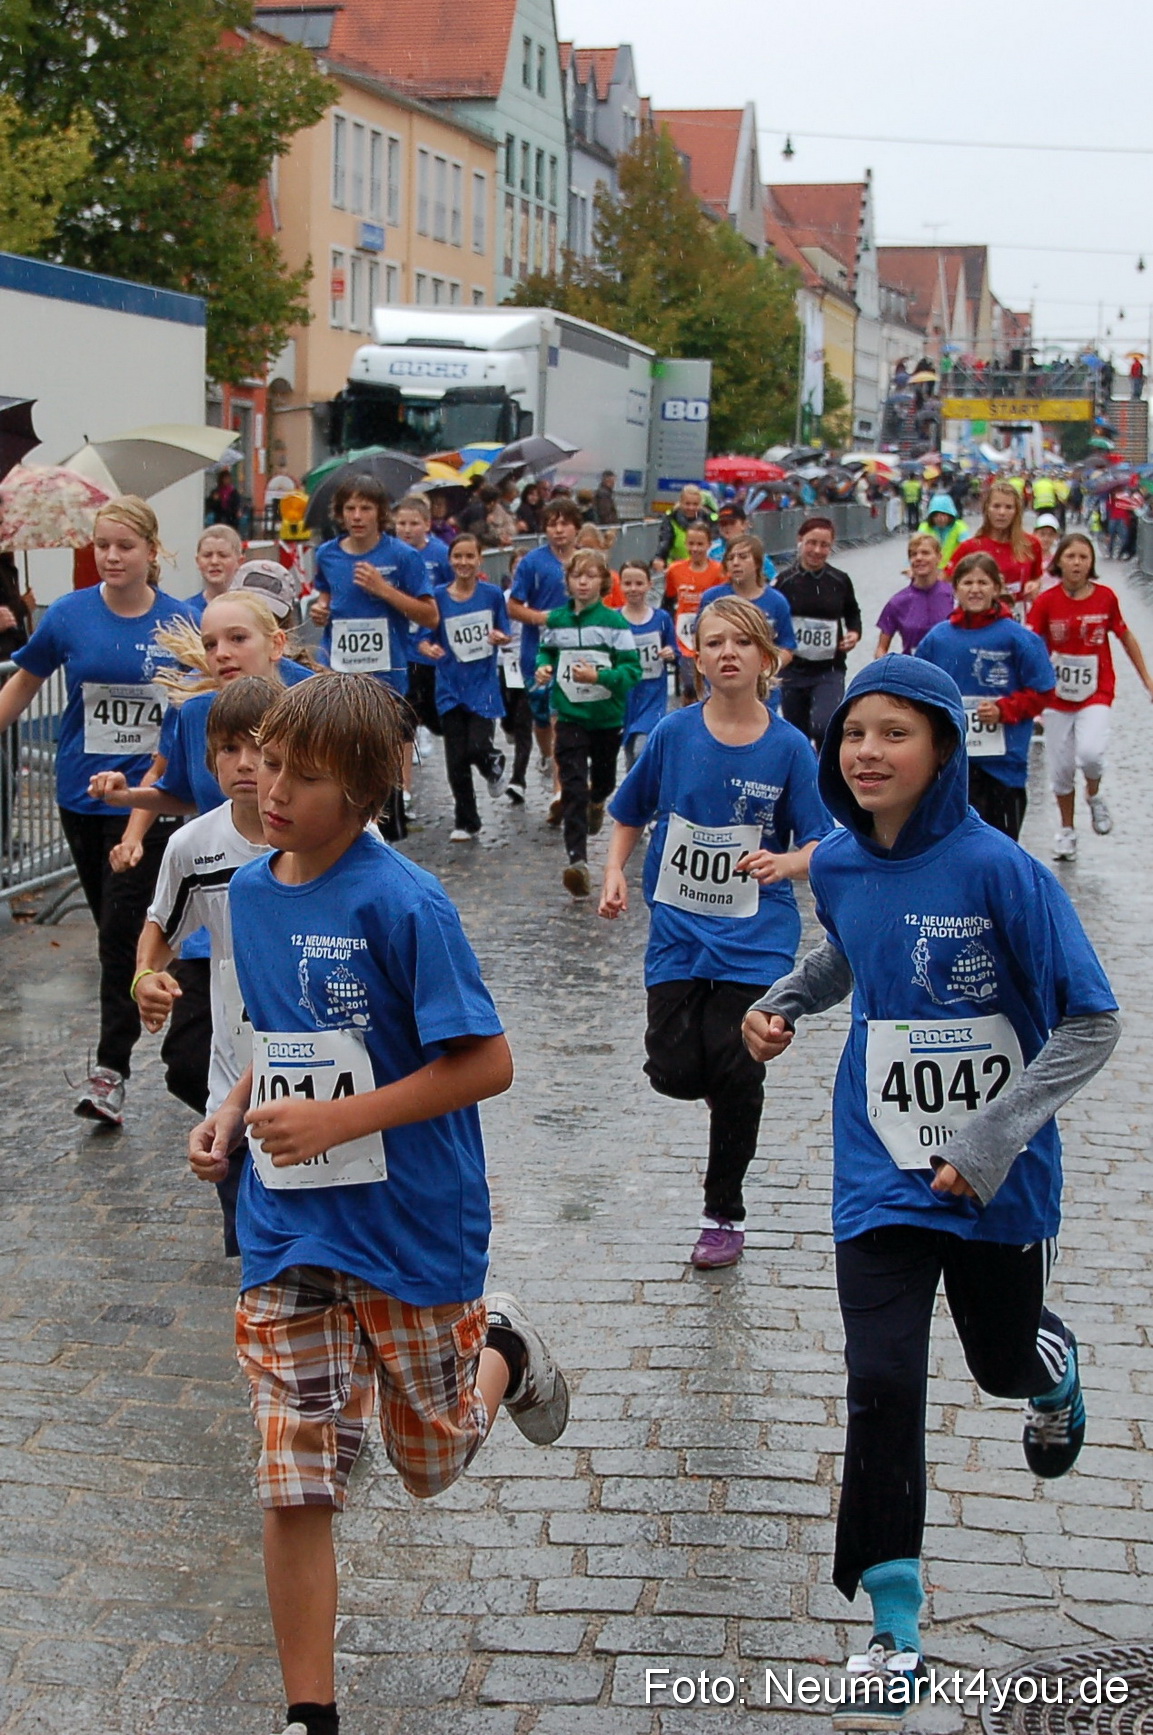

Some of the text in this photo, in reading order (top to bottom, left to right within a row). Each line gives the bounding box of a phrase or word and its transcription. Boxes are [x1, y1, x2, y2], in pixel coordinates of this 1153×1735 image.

[989, 404, 1040, 417] START
[337, 632, 384, 653] 4029
[93, 698, 163, 727] 4074
[114, 731, 142, 744] Jana
[670, 844, 751, 885] 4004
[679, 883, 734, 905] Ramona
[904, 914, 920, 925] 12.
[919, 926, 984, 938] STADTLAUF
[291, 935, 368, 950] 12. NEUMARKTER
[302, 947, 352, 961] STADTLAUF
[909, 1027, 974, 1045] BOCK
[267, 1043, 316, 1058] BOCK
[881, 1054, 1012, 1113] 4042
